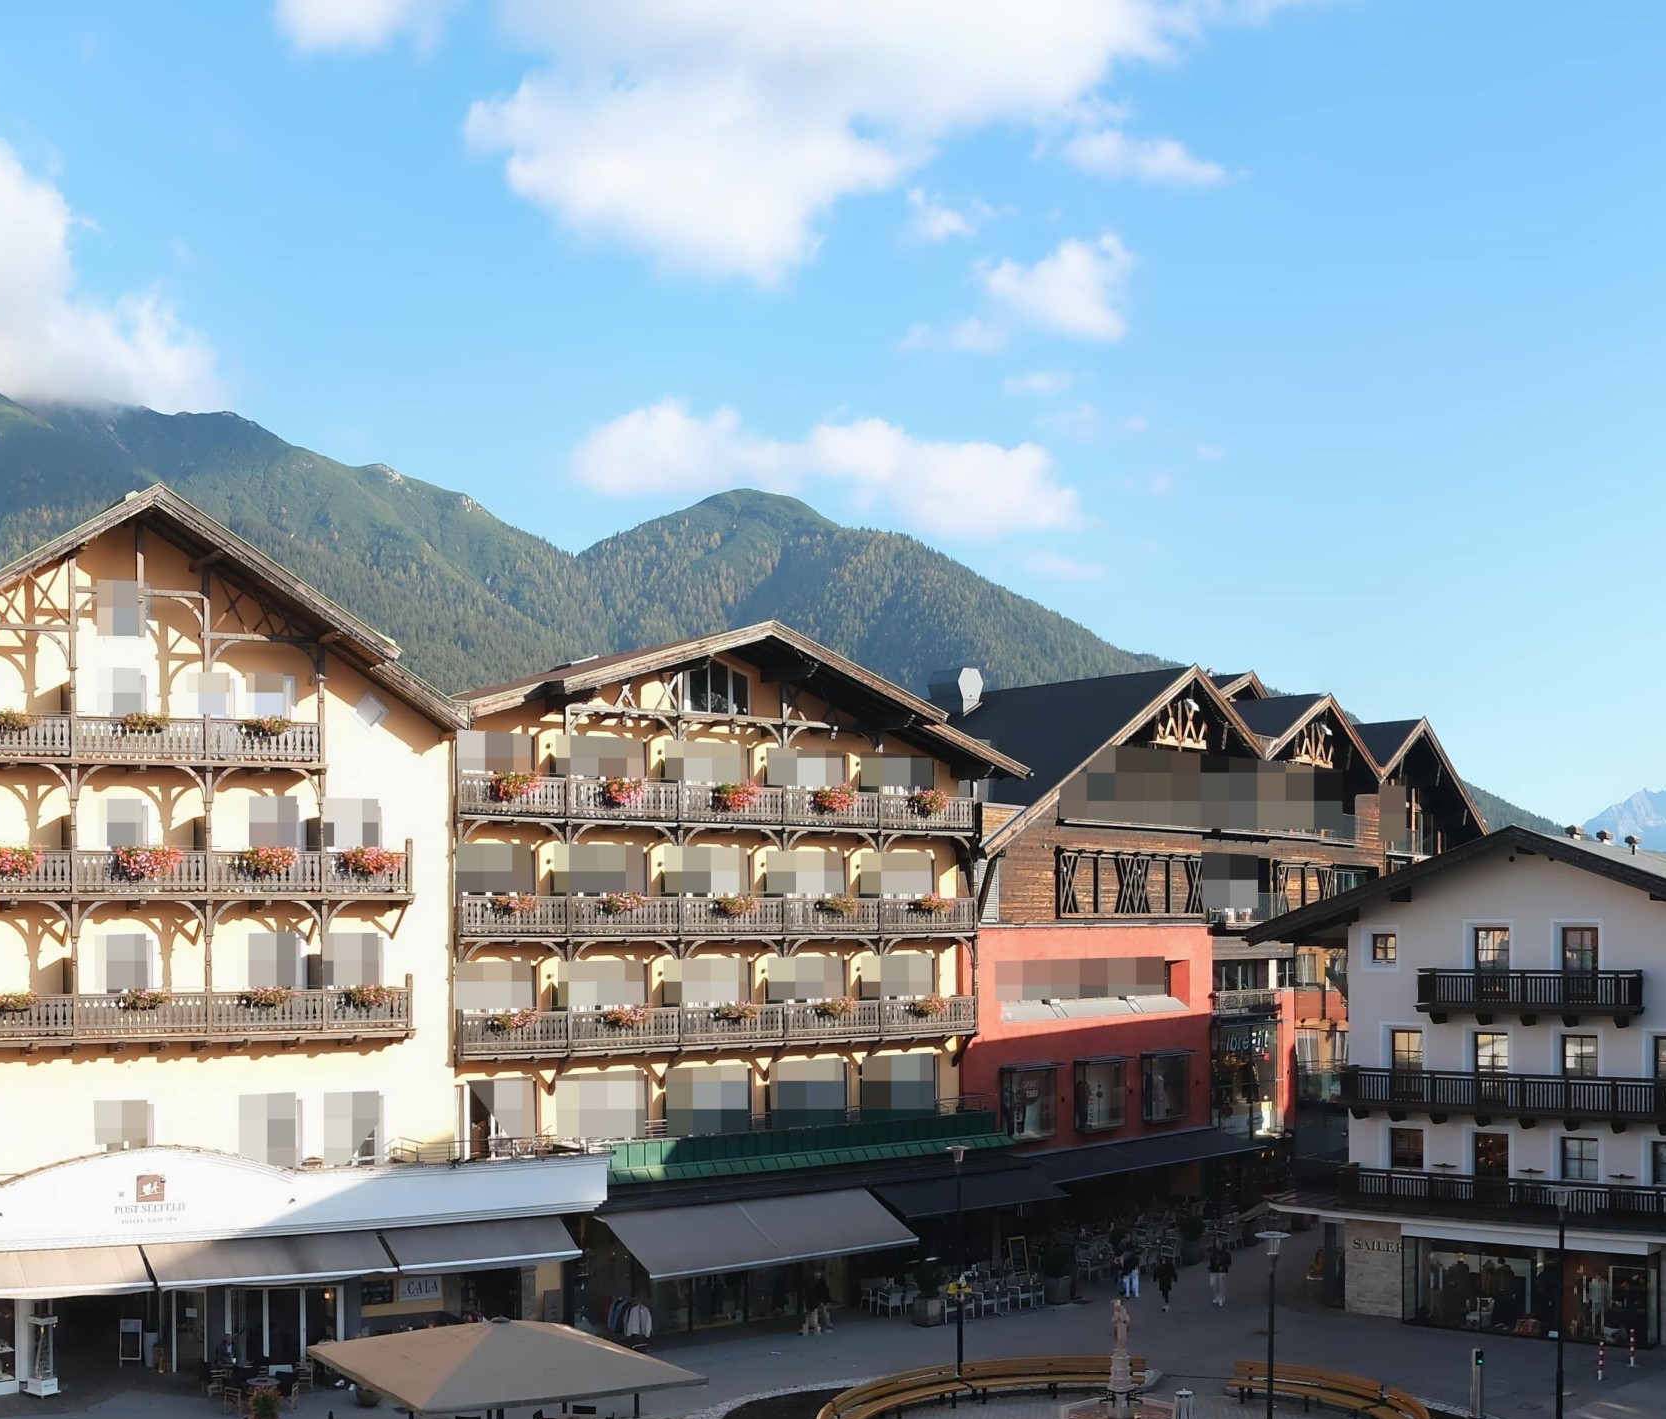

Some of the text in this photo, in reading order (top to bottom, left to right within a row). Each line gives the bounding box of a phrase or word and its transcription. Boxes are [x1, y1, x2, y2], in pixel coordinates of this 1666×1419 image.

[114, 1202, 186, 1214] POST SEEFELD
[407, 1279, 438, 1295] CALA
